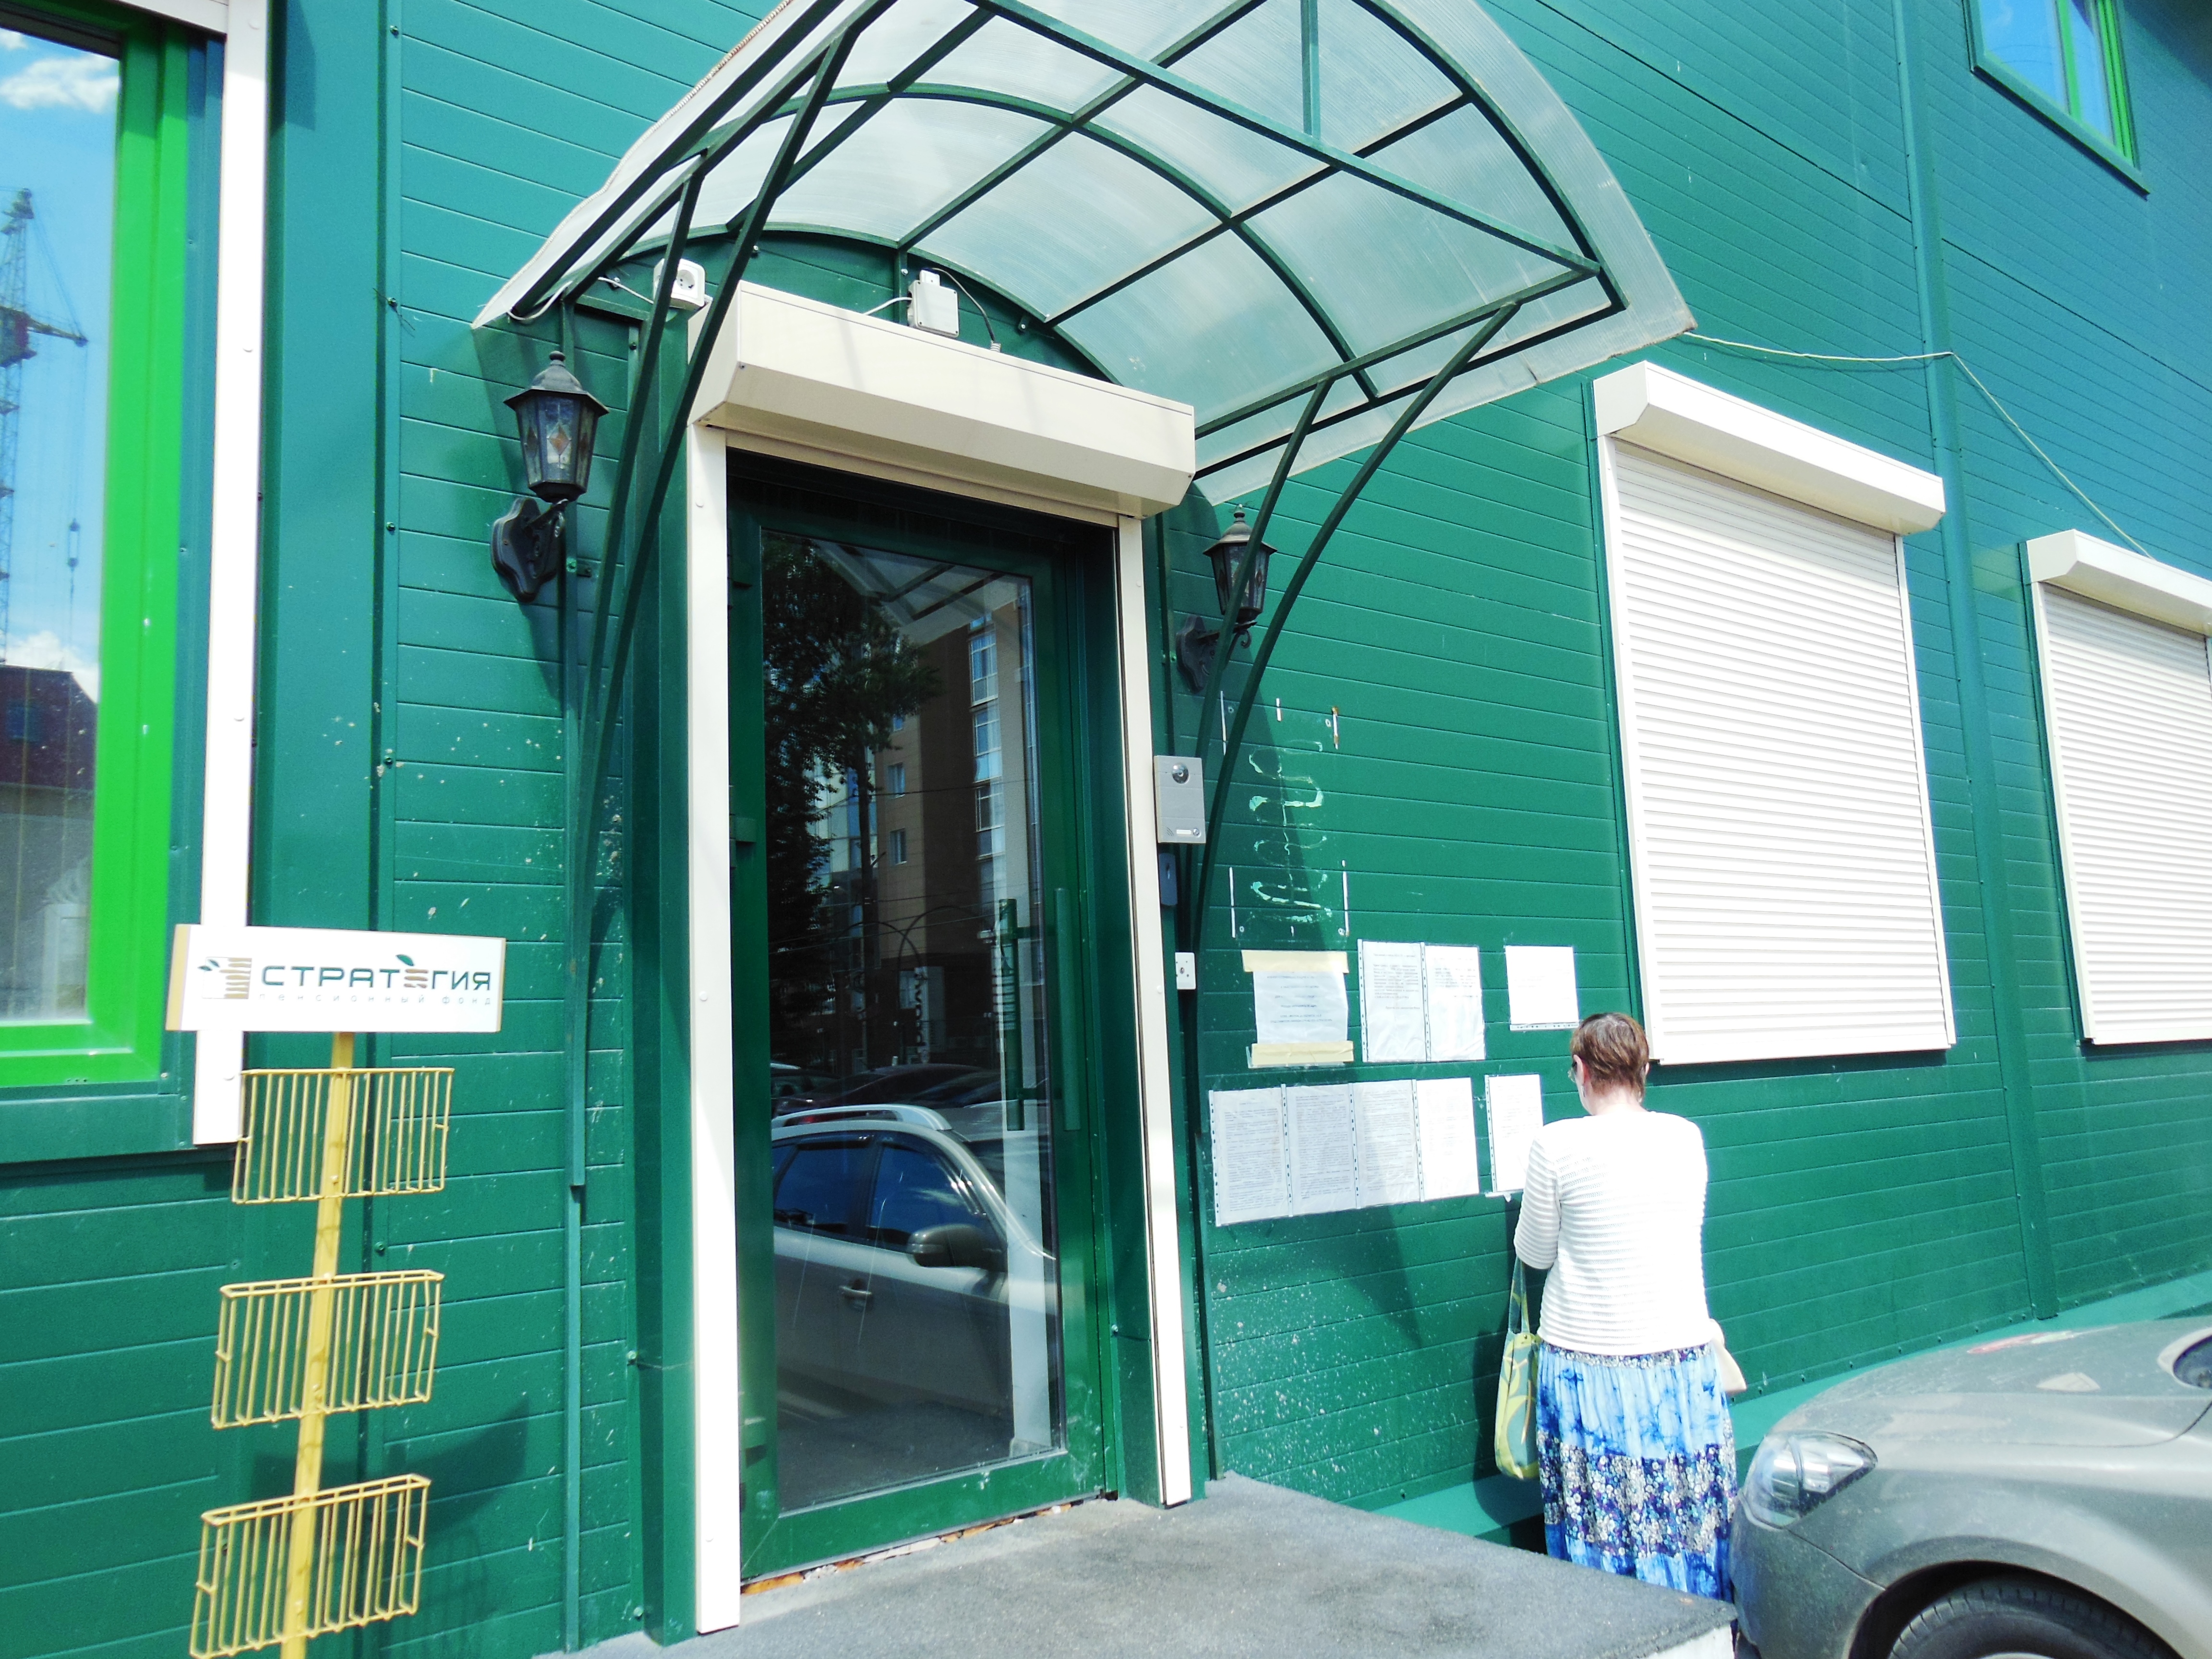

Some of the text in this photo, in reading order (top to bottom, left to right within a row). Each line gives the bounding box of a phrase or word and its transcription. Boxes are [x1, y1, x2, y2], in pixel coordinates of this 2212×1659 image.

[262, 965, 491, 991] СТРАТЕГИЯ
[259, 994, 491, 1005] пенсионный фонд
